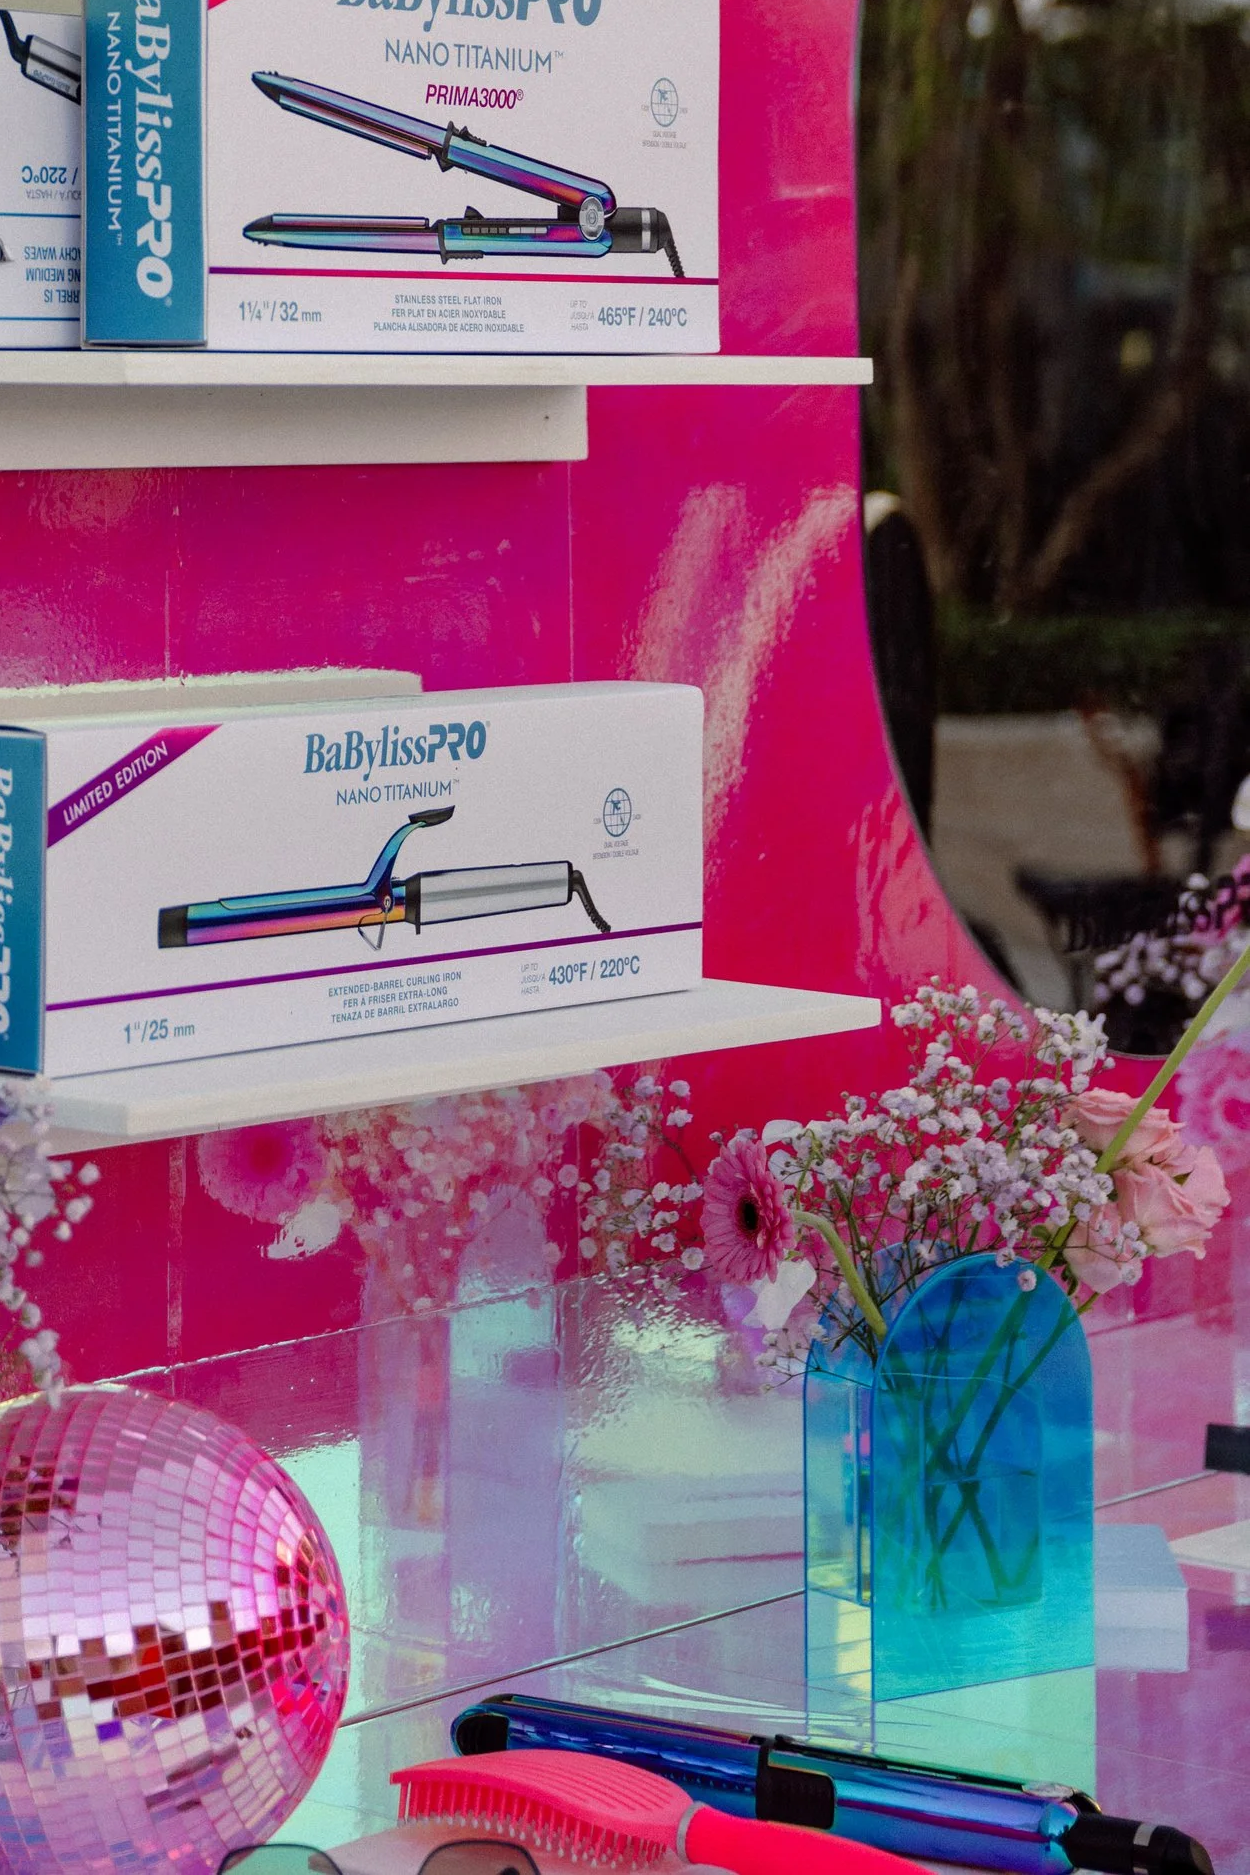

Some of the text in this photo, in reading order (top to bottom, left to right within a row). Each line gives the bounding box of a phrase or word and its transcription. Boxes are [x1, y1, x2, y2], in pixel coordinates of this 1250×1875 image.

[107, 11, 121, 96] NANO
[385, 38, 449, 68] NANO
[26, 189, 52, 201] HASTA
[24, 247, 57, 261] WAVES
[25, 268, 65, 282] MEDIUM
[43, 289, 53, 303] IS
[394, 294, 502, 306] STAINLESS STEEL FLAT IRON
[391, 308, 506, 320] FER PLAT EN ACIER INOXYDABLE
[638, 307, 644, 327] /
[373, 321, 525, 333] PLANCHA ALISADORA DE ACERO INOXIDABLE
[63, 740, 168, 825] LIMITED EDITION
[336, 786, 381, 805] NANO
[590, 960, 596, 982] /
[329, 971, 462, 997] EXTENDED-BARREL CURLING IRON
[344, 998, 358, 1009] FER
[368, 993, 396, 1005] FRISER
[398, 986, 448, 1001] EXTRA-LONG
[331, 998, 459, 1023] TENAZA DE BARRIL EXTRALARGO
